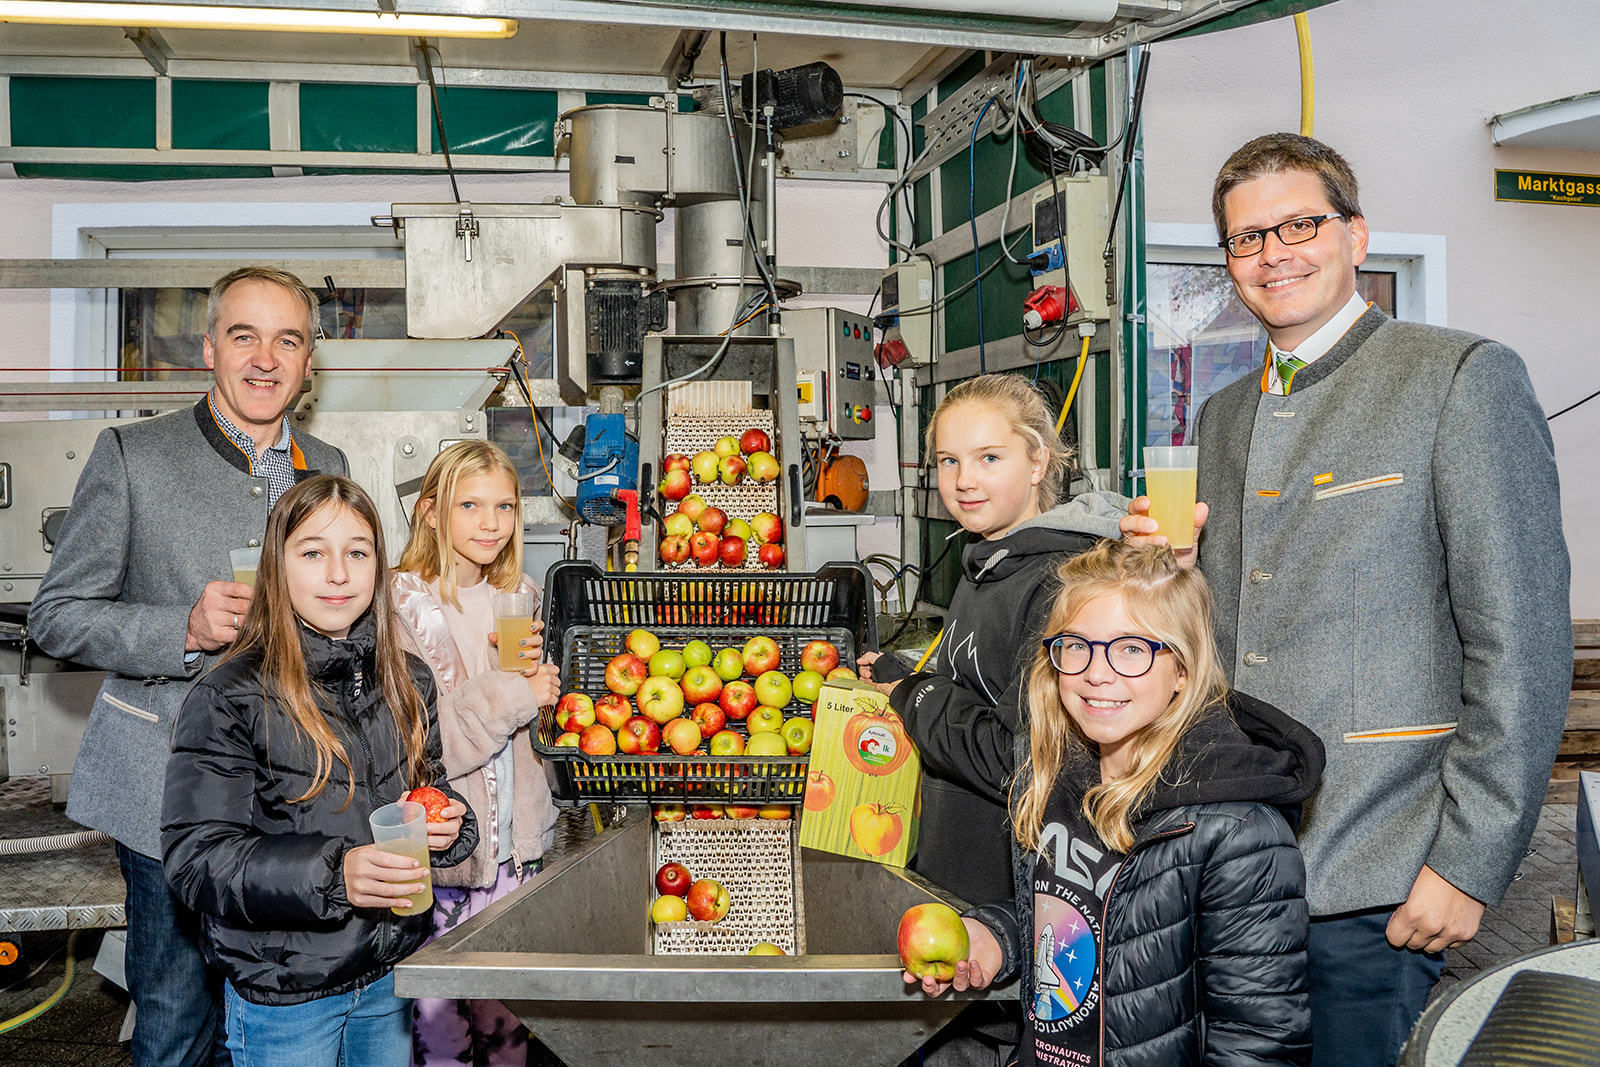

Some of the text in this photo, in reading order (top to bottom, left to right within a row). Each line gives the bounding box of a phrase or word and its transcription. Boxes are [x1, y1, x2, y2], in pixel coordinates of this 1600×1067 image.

[826, 702, 854, 713] 5 Liter
[1055, 884, 1081, 906] THE
